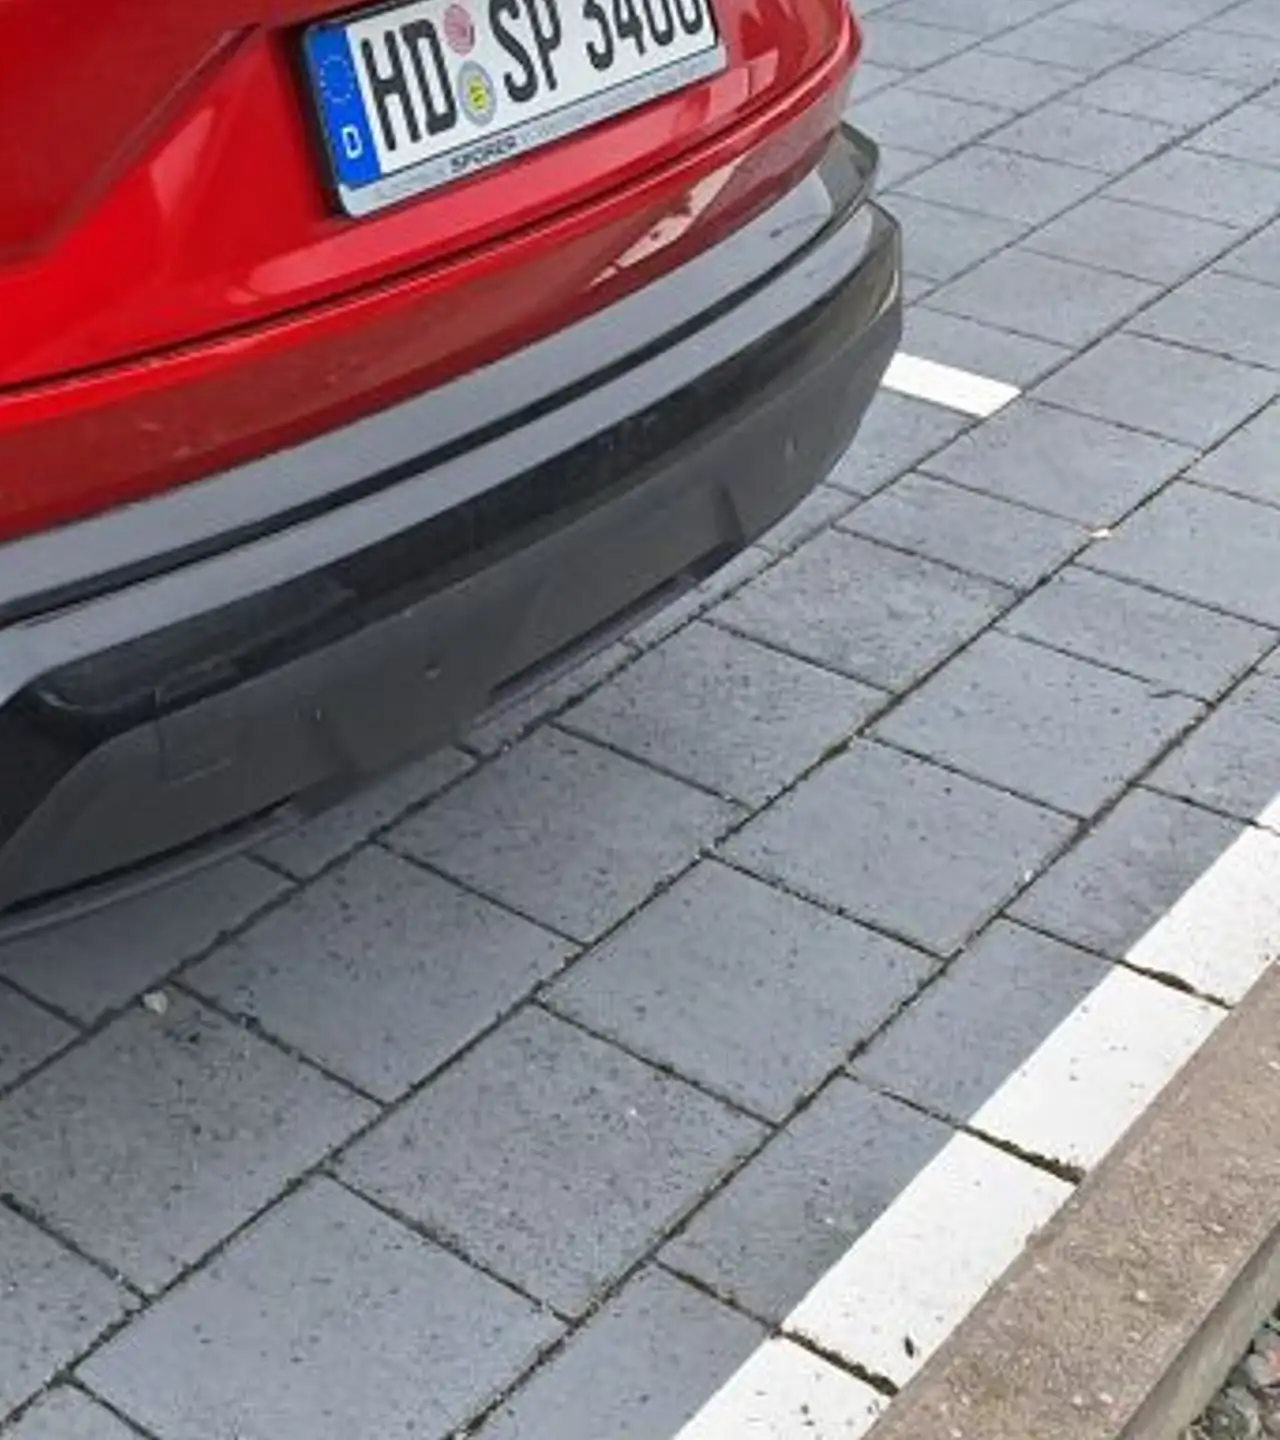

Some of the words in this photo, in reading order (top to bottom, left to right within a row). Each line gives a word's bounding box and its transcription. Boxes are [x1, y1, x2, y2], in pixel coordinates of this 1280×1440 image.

[361, 18, 458, 151] HD
[340, 126, 362, 160] D
[449, 137, 518, 175] SPORER
